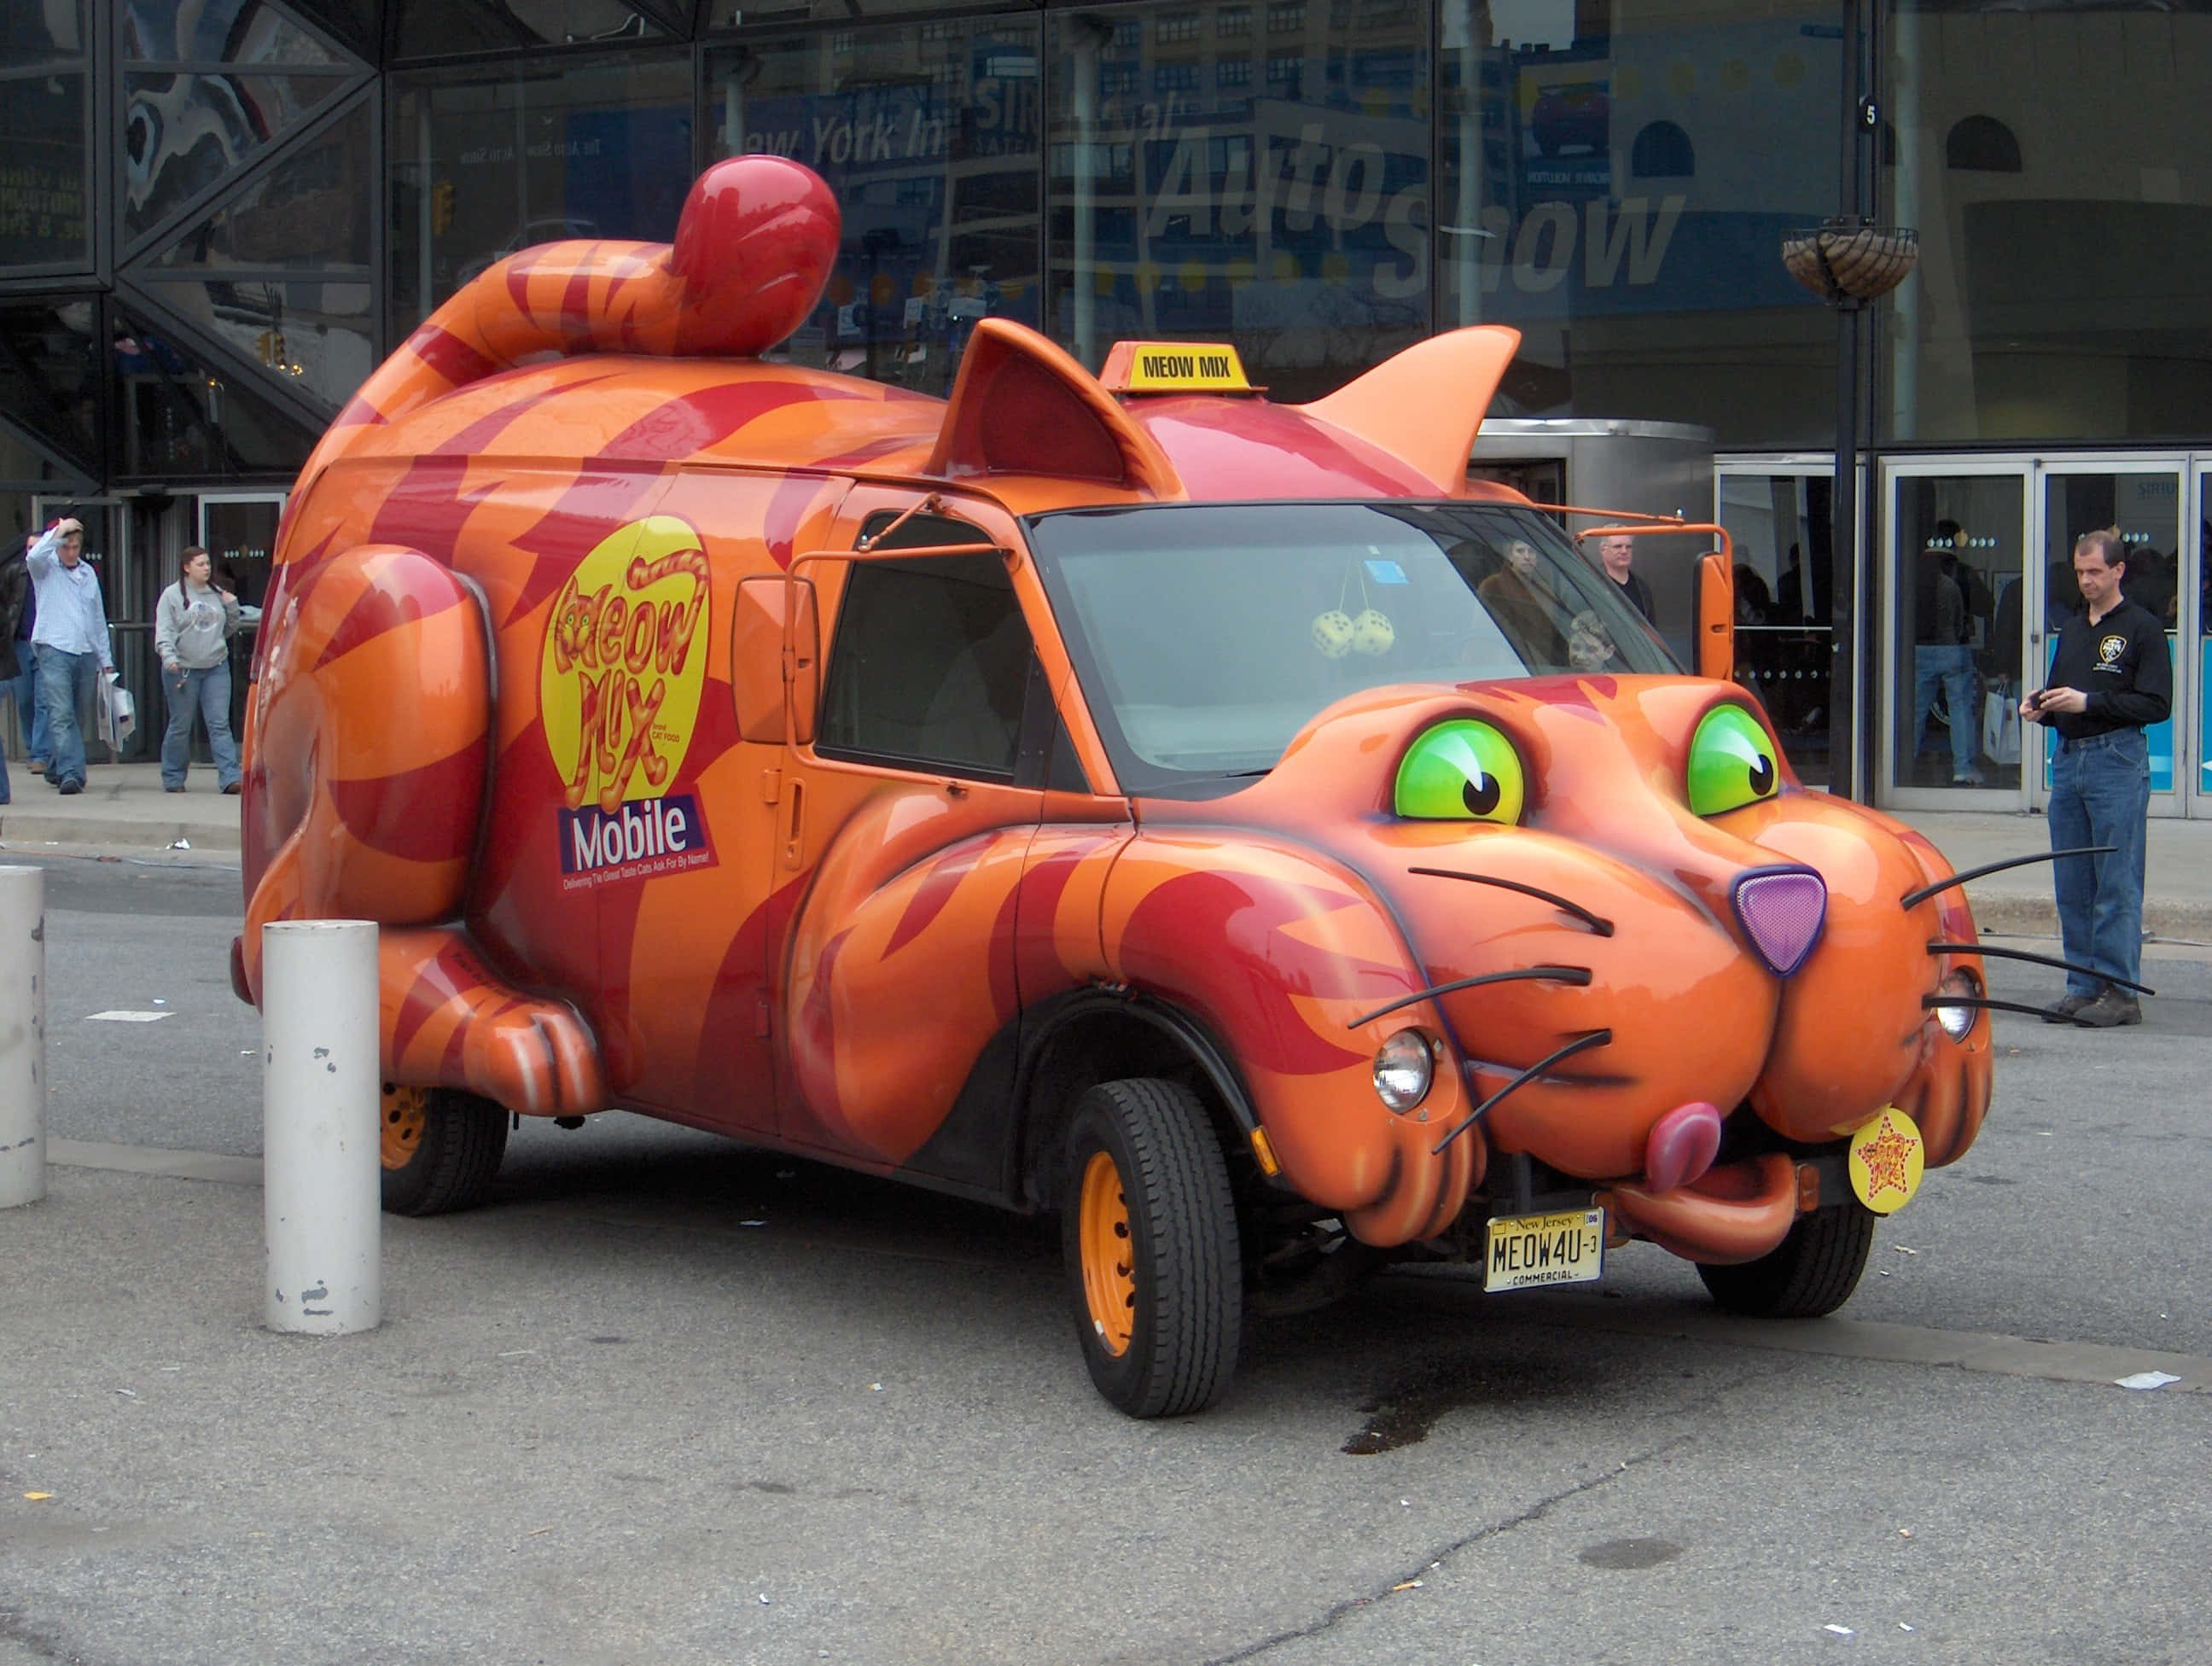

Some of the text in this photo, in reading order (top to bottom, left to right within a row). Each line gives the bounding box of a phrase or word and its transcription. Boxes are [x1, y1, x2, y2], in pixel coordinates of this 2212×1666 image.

[1866, 104, 1877, 125] 5
[812, 111, 896, 165] York
[1146, 123, 1386, 237] Auto
[1143, 356, 1231, 378] MEOW MIX
[2138, 481, 2177, 496] SIRIU
[652, 731, 680, 743] CAT FOOD
[573, 799, 687, 871] Mobile
[603, 870, 620, 883] Great
[637, 863, 653, 876] Cats
[654, 860, 666, 872] Ask
[667, 858, 677, 870] For
[678, 856, 688, 870] By
[1515, 1215, 1575, 1232] New Jersey
[1512, 1269, 1573, 1286] COMMERCIAL
